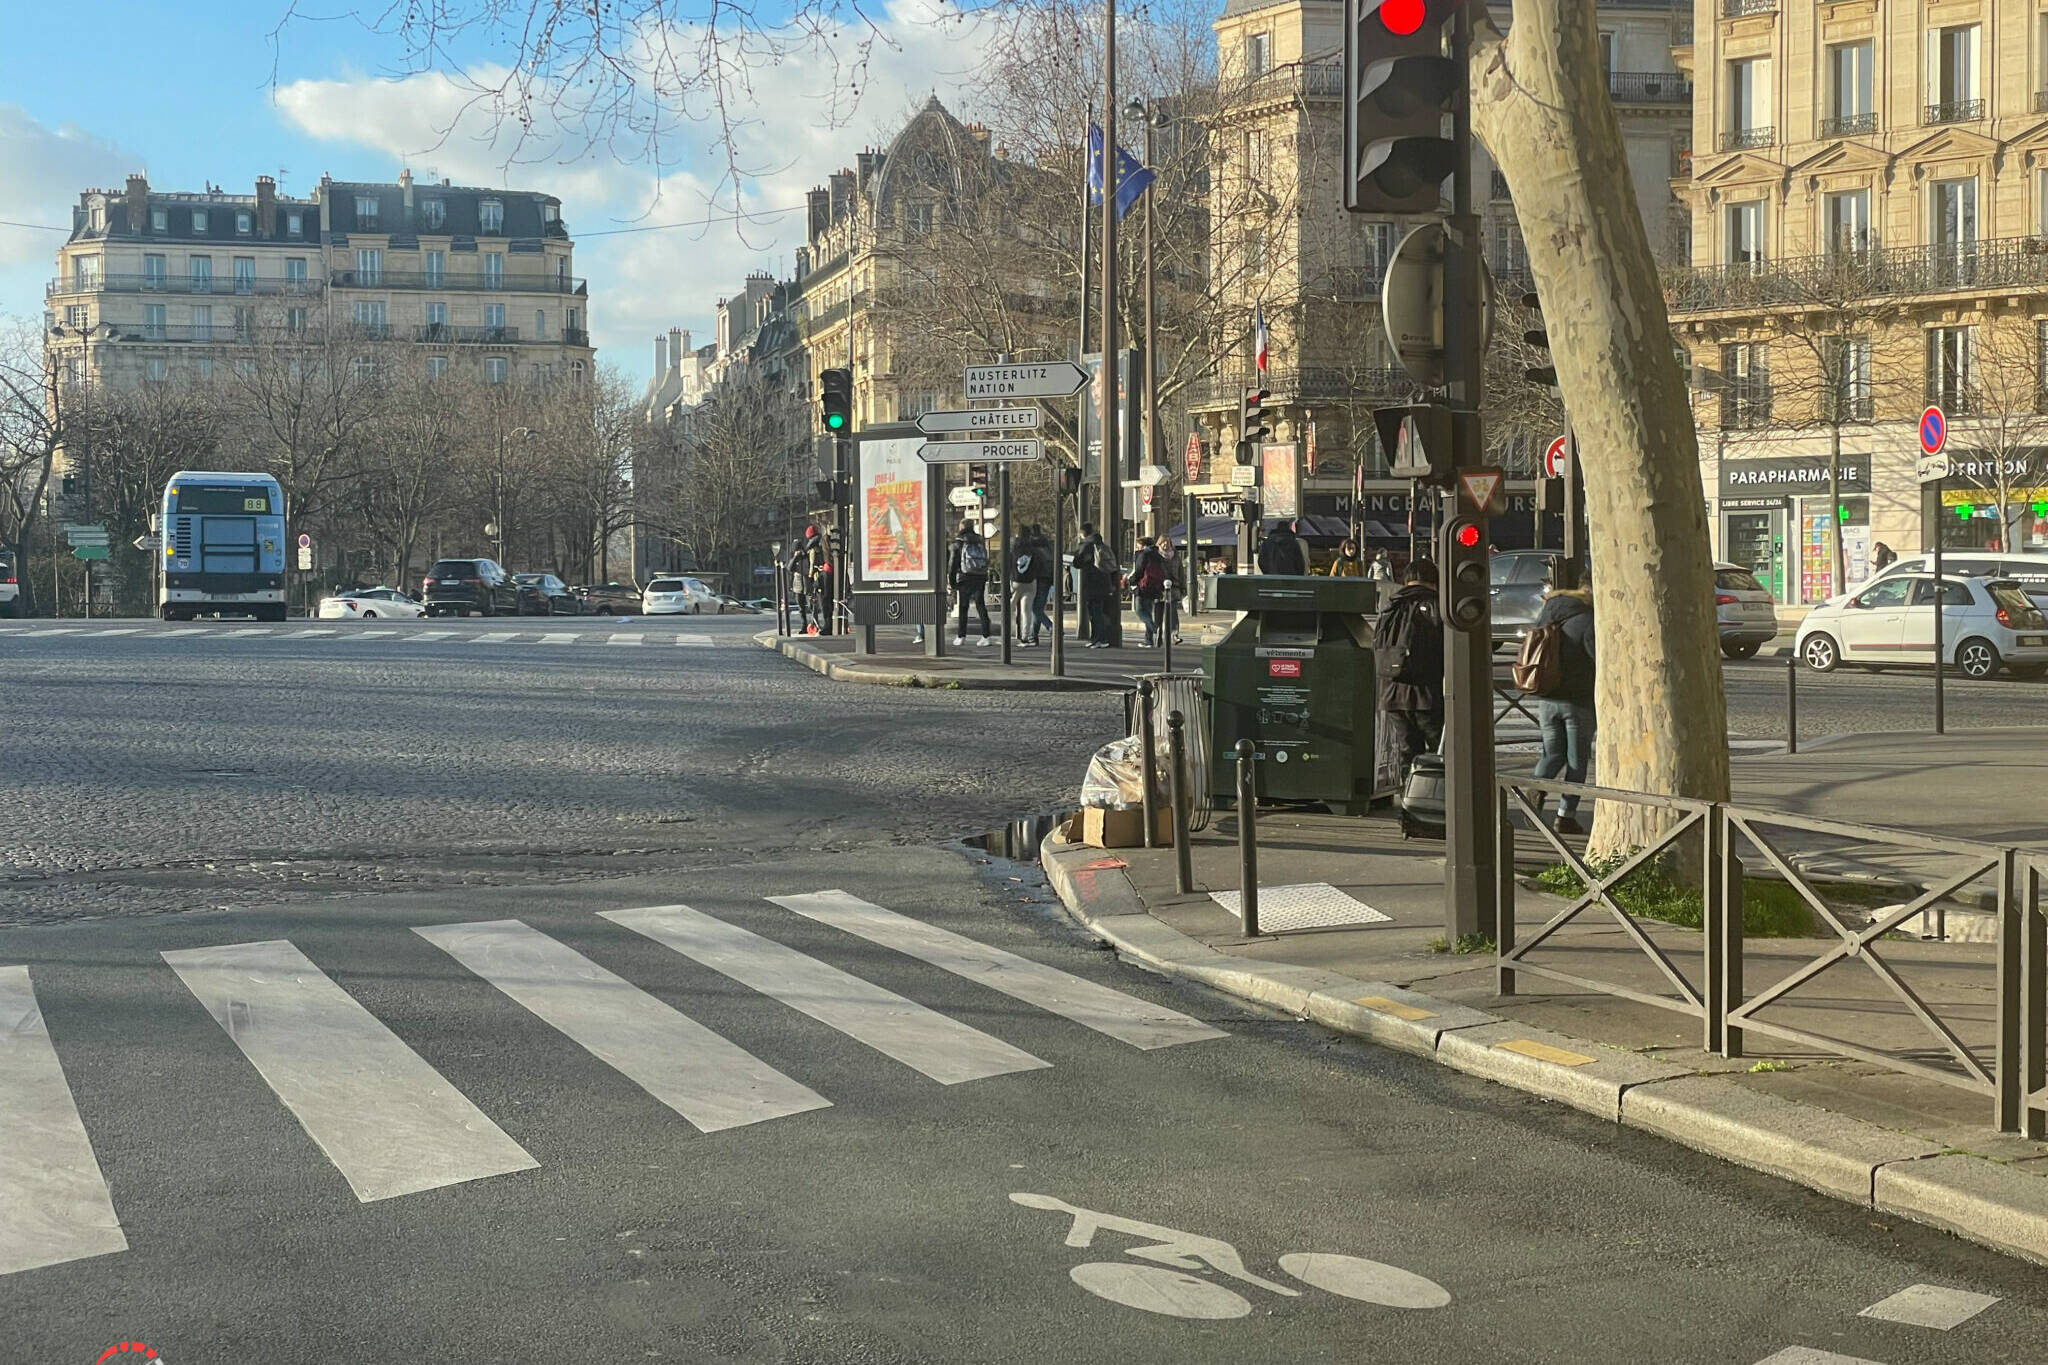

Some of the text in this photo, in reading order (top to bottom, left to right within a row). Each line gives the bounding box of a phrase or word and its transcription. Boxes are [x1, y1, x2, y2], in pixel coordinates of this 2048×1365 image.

[970, 368, 1047, 381] AUSTERLITZ
[970, 383, 1015, 394] NATION
[971, 413, 1033, 426] CHÂTELET
[982, 445, 1029, 456] PROCHE
[1948, 460, 2028, 477] UTRITION
[1729, 467, 1857, 484] PARAPHARMAIE
[247, 499, 262, 510] 88
[1335, 495, 1444, 512] MNCEAU
